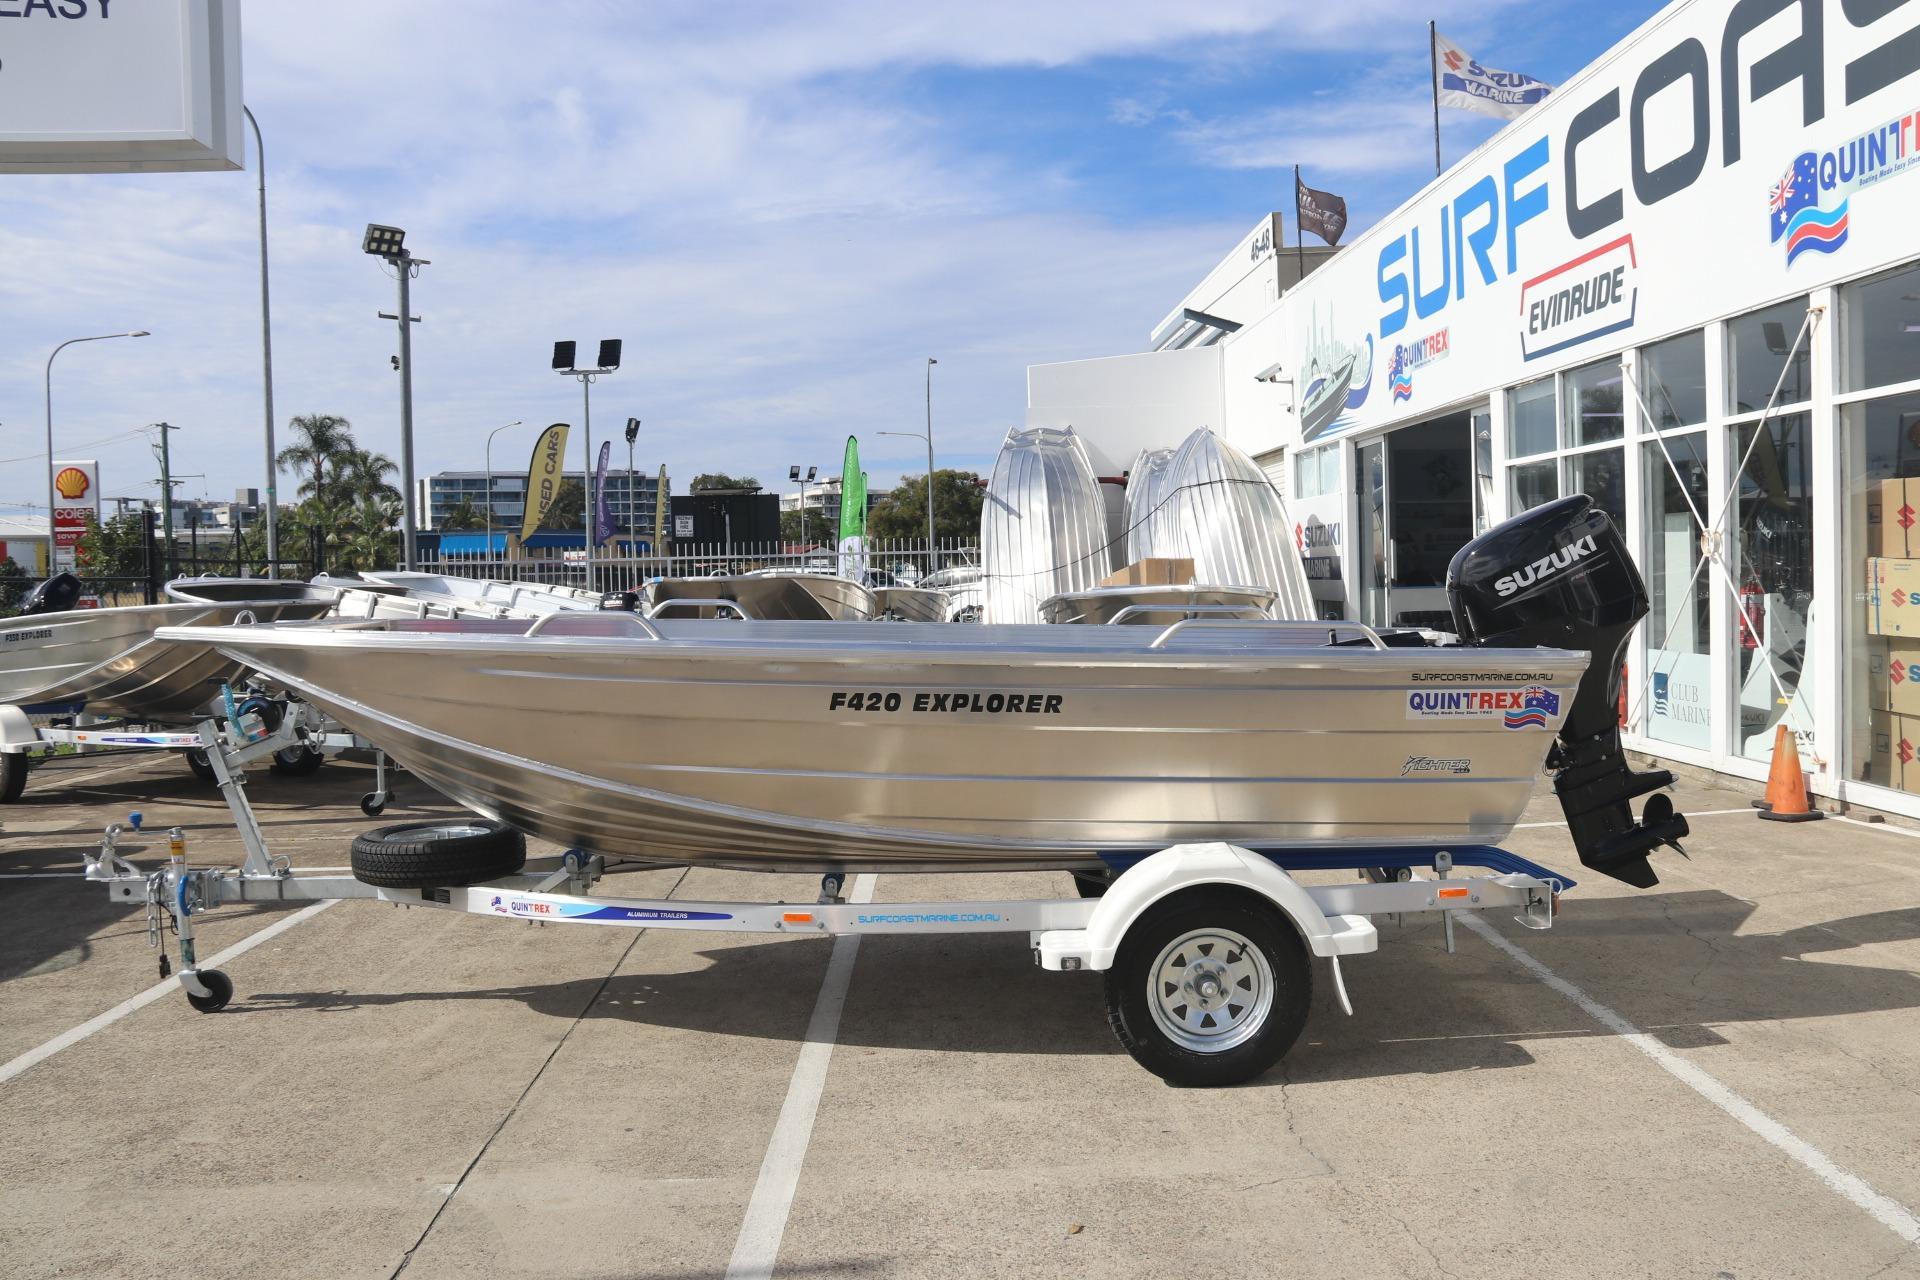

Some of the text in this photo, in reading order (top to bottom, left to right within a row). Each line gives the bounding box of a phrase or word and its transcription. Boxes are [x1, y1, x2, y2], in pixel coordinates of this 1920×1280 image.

[1464, 80, 1525, 103] MARINE
[1819, 111, 1920, 192] QUINT
[1879, 167, 1893, 178] Made
[1894, 161, 1906, 172] Easy
[1251, 228, 1270, 262] 46-48
[1529, 265, 1625, 335] EVINRUDE
[1403, 329, 1448, 367] QUINTREX
[545, 430, 560, 475] CARS
[1305, 522, 1341, 549] SUZUKI
[1304, 558, 1331, 578] MARINE
[1494, 534, 1598, 597] SUZUKI
[1411, 673, 1554, 681] SURFCOASTMARINE.COM.AU
[829, 692, 1064, 713] F420 EXPLORER
[1409, 692, 1524, 711] QUINTREX
[1671, 683, 1699, 703] CLUB
[511, 901, 551, 914] QUINTREX
[858, 914, 1000, 923] SURFCOASTMARINE.COM.AU
